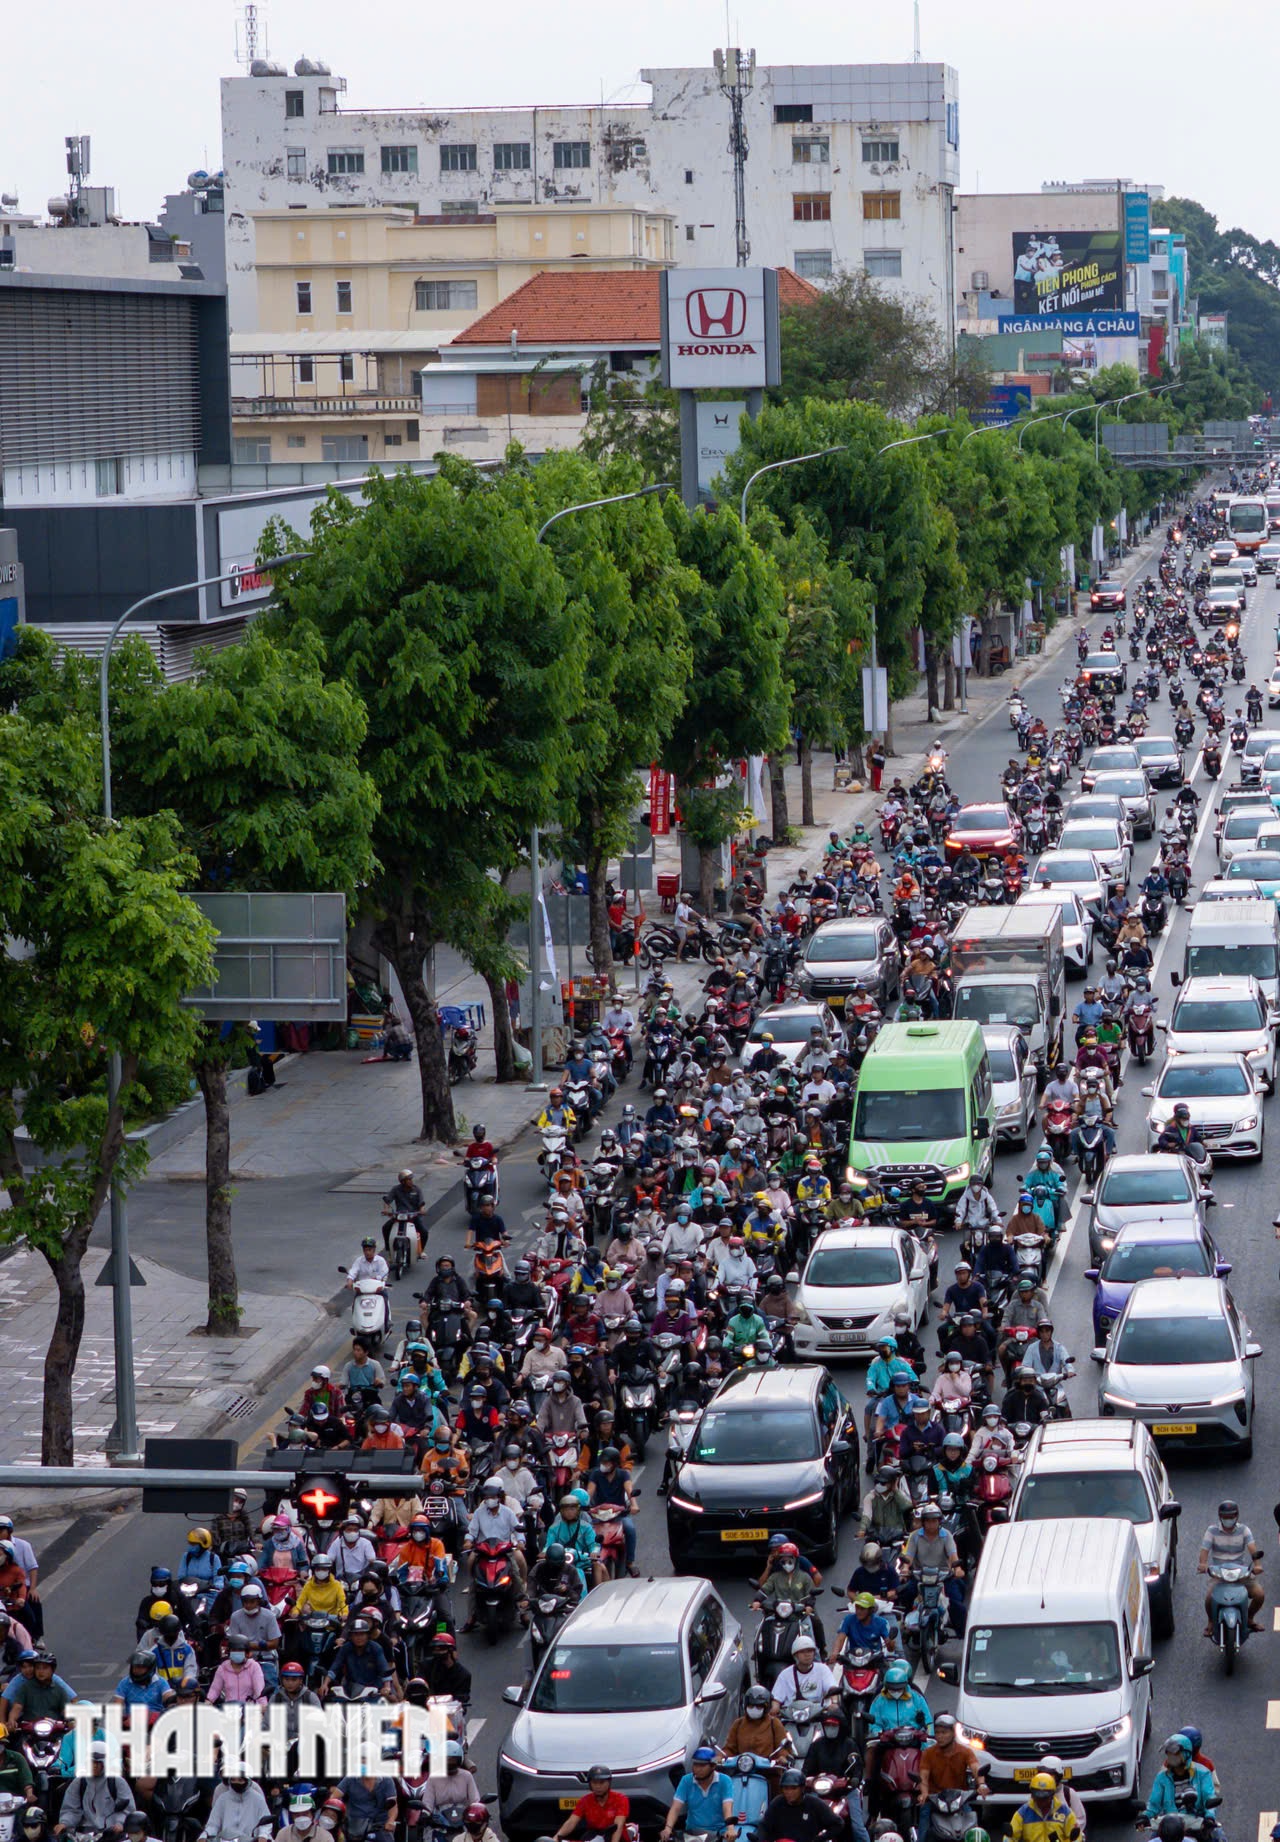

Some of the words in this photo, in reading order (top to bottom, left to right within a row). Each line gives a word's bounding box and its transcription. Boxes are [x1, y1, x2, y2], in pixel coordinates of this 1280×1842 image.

[1062, 262, 1099, 288] PHONG
[1038, 291, 1059, 315] KẾT
[1062, 284, 1080, 308] NỐI
[1003, 320, 1041, 333] NGÂN
[1045, 319, 1083, 332] HÀNG
[1086, 318, 1096, 332] Á
[1098, 318, 1135, 331] CHÂU
[677, 344, 757, 355] HONDA
